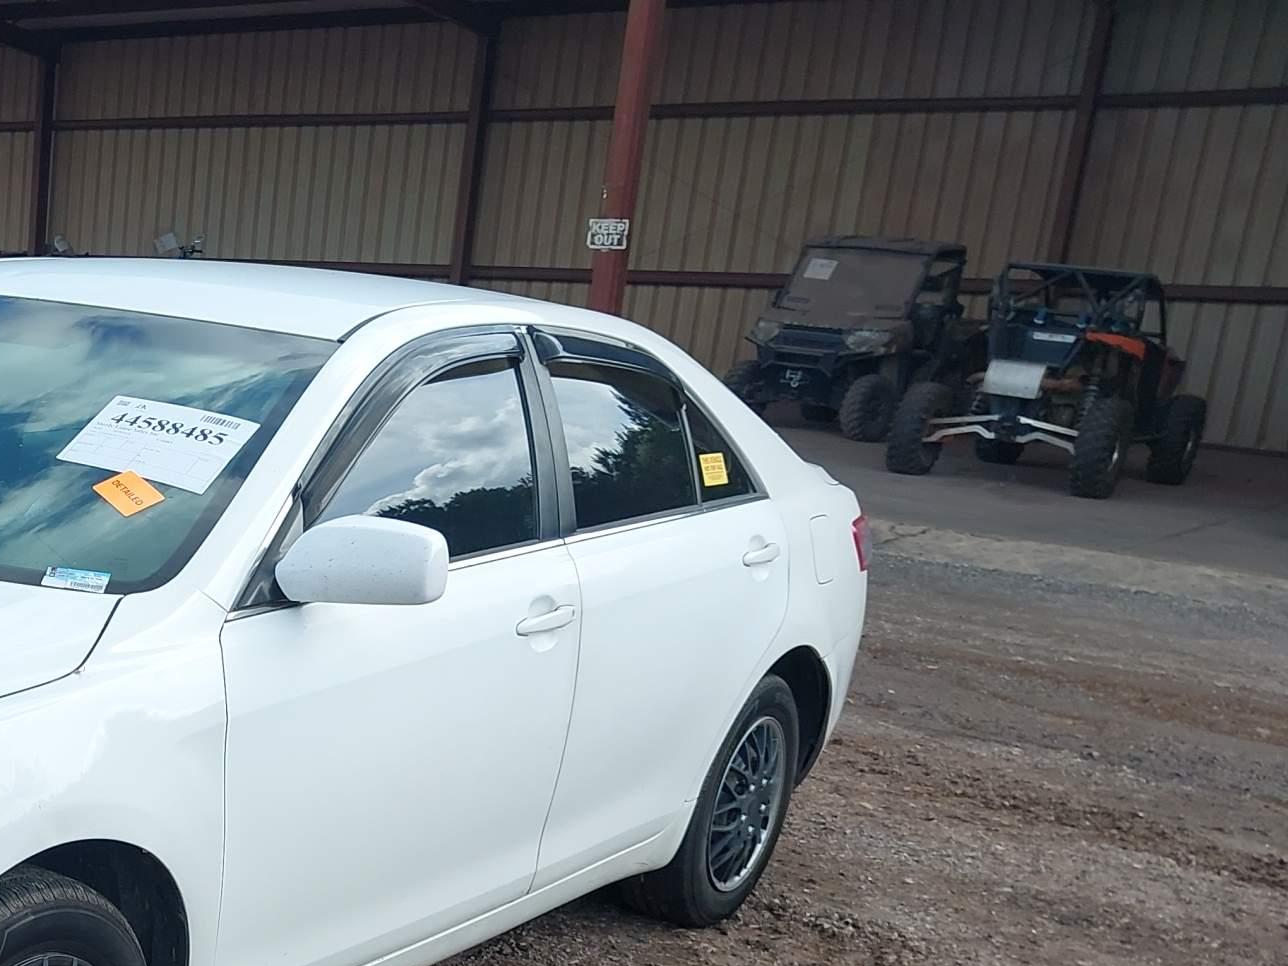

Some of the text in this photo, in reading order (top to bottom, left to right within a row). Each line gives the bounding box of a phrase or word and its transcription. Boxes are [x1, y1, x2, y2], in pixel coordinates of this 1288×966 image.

[592, 223, 625, 234] KEEP
[594, 235, 620, 245] OUT
[111, 412, 229, 445] 44588485
[111, 479, 144, 506] DETAILED
